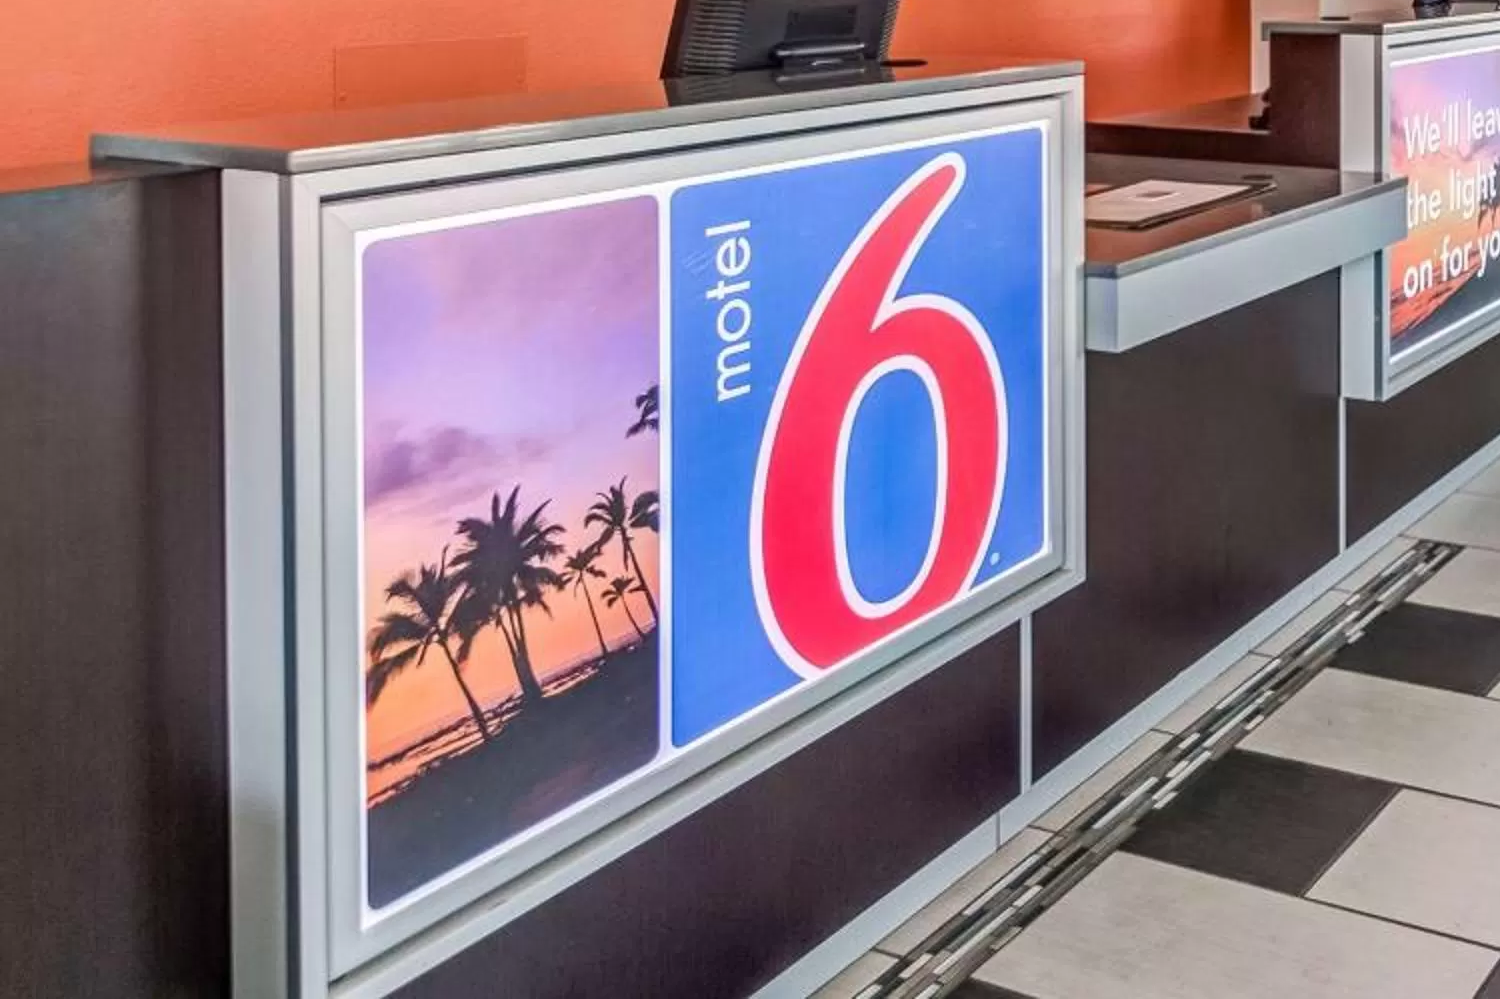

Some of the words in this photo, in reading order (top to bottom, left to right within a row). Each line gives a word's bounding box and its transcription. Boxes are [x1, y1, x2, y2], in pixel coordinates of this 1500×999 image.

[1403, 101, 1459, 160] We'll
[1406, 180, 1442, 230] the
[1450, 160, 1497, 220] light
[1403, 258, 1433, 298] on
[1440, 234, 1473, 282] for
[704, 220, 751, 402] motel
[749, 151, 1009, 681] 6
